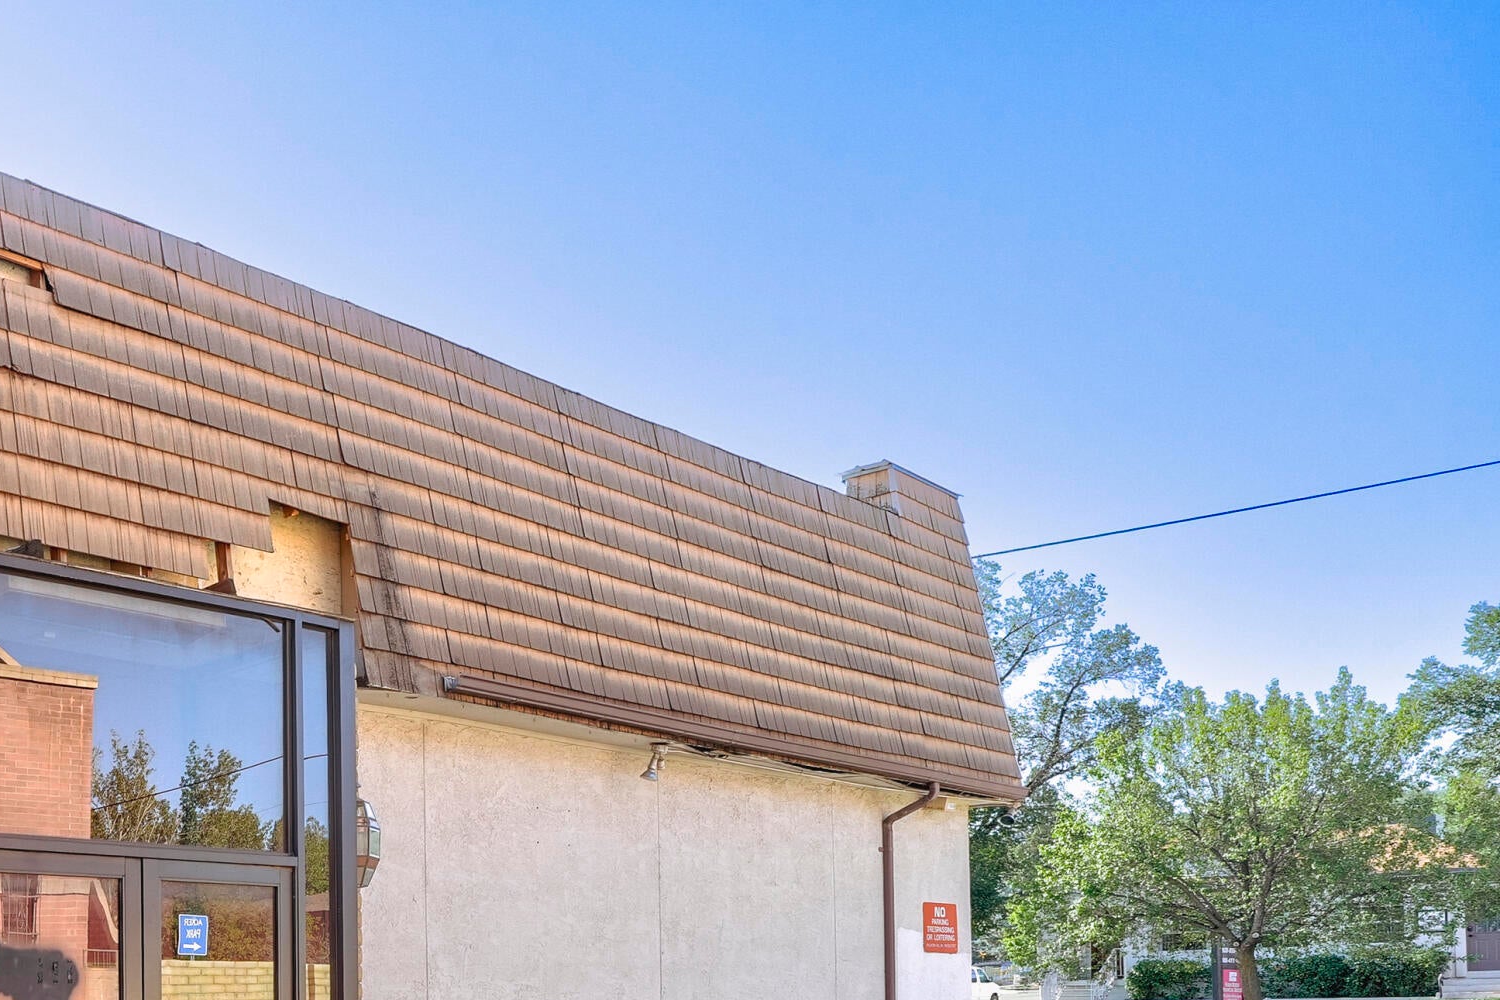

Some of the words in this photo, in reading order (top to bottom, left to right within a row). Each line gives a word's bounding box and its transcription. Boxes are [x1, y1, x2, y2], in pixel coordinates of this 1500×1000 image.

[934, 906, 946, 918] NO
[931, 918, 949, 926] PARKING
[926, 926, 955, 934] TRESPASSING
[933, 934, 956, 942] LOITERING
